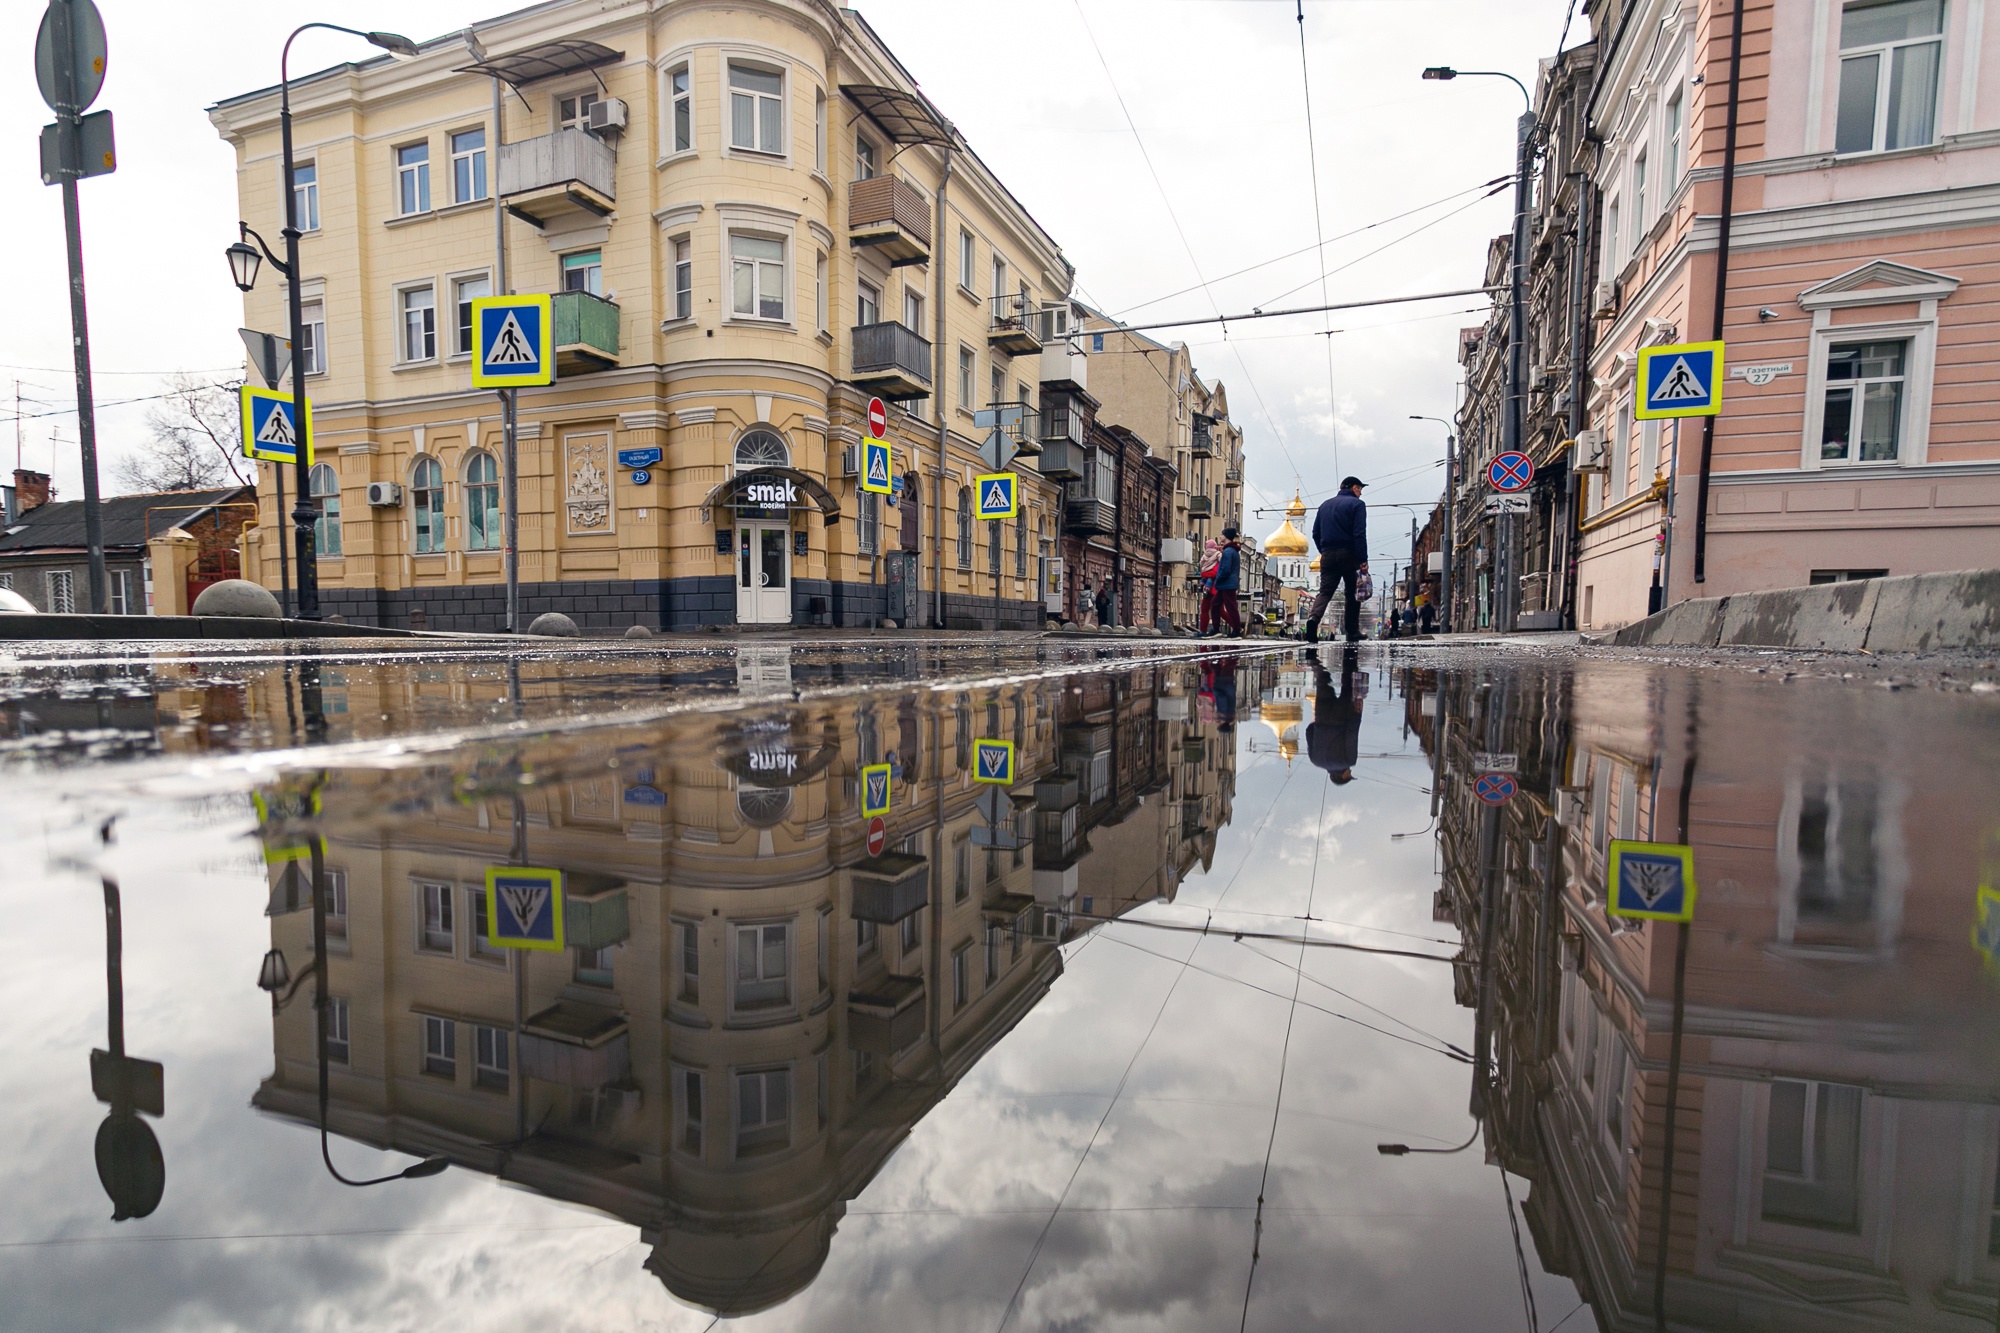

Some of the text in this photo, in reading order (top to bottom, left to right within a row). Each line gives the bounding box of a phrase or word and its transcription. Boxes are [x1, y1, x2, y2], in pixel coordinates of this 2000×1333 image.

[1747, 364, 1789, 374] Газетный
[1753, 373, 1769, 383] 27
[635, 472, 645, 481] 25
[747, 478, 797, 502] smak
